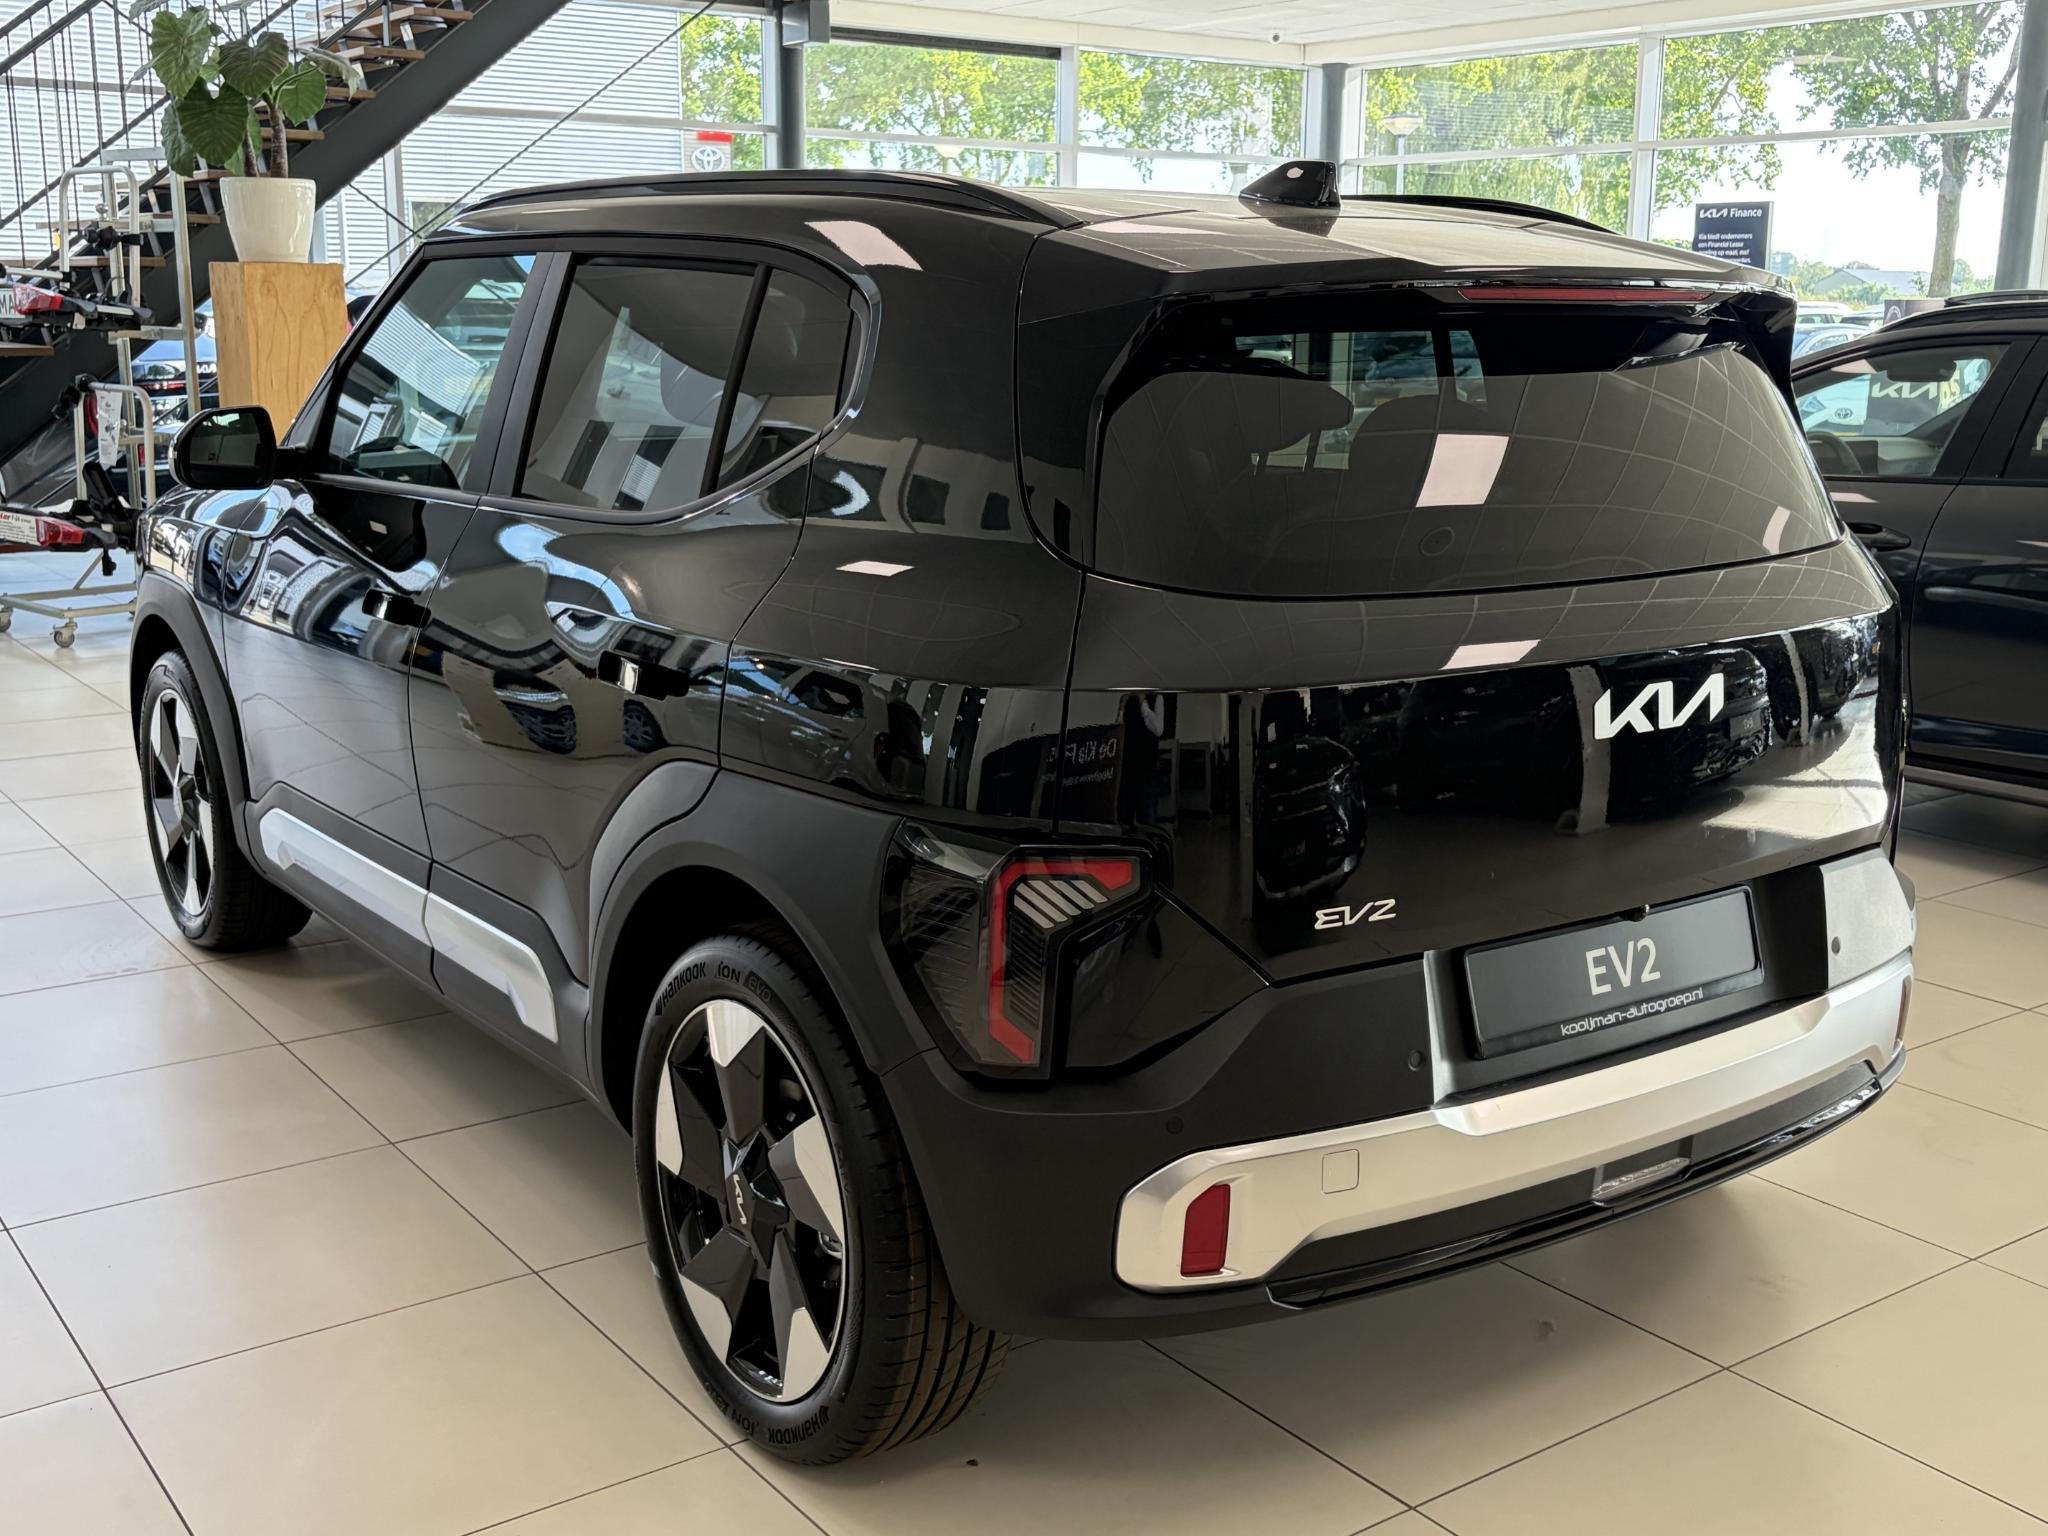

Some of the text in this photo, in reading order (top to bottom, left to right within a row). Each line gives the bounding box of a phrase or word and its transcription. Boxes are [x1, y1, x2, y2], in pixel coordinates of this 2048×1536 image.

[1700, 208, 1762, 218] KIA Finance
[1872, 381, 1938, 398] KIA
[1594, 672, 1724, 740] KIA
[1314, 898, 1397, 930] EV2
[1585, 937, 1661, 996] EV2
